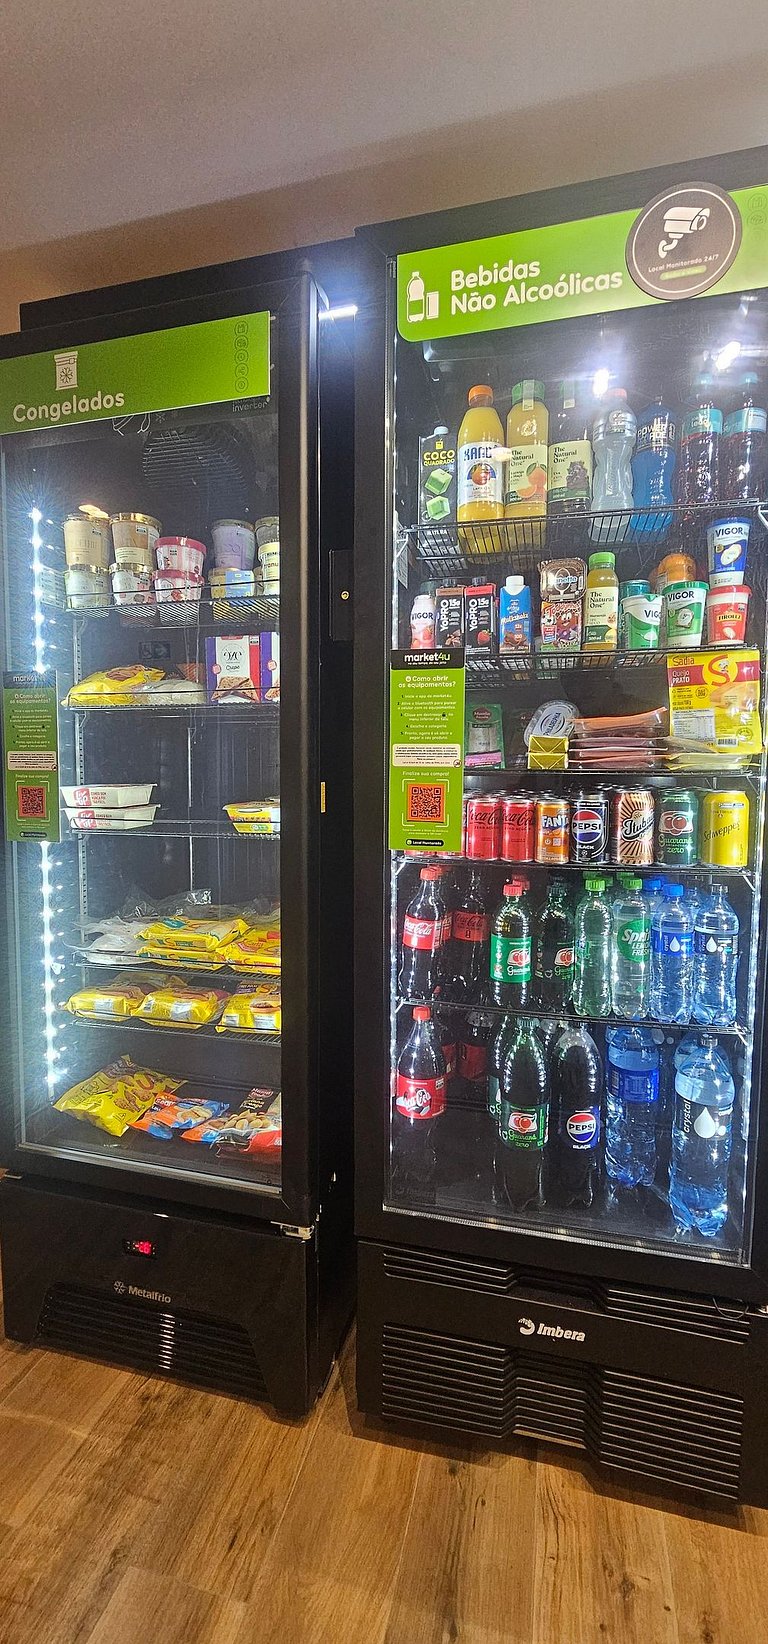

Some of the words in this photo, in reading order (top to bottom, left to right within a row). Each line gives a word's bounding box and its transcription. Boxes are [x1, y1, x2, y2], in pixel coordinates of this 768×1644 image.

[648, 264, 665, 273] Local
[666, 258, 702, 269] Monitorado
[704, 254, 719, 262] 24/7
[451, 259, 541, 291] Bebidas
[451, 291, 497, 315] Não
[503, 271, 623, 307] Alcoólicas
[13, 391, 125, 422] Congelados
[232, 401, 267, 412] inverter
[423, 449, 455, 460] COCO
[554, 450, 578, 458] Natural
[423, 458, 455, 466] QUADRADO
[715, 527, 743, 537] VIGOR
[667, 591, 694, 601] VIGOR
[411, 612, 433, 620] VIGOR
[440, 600, 449, 632] YoPRO
[469, 599, 478, 631] YoPRO
[644, 610, 661, 618] VIG
[404, 653, 450, 662] market4u
[672, 655, 695, 666] Sadia
[672, 670, 689, 678] Queijo
[407, 680, 456, 688] equipamentos?
[704, 822, 740, 842] Schweppes
[683, 1099, 692, 1133] crystal
[569, 1123, 595, 1131] PEPSI
[128, 1285, 171, 1303] Metalfrio
[537, 1322, 586, 1342] Imbera
